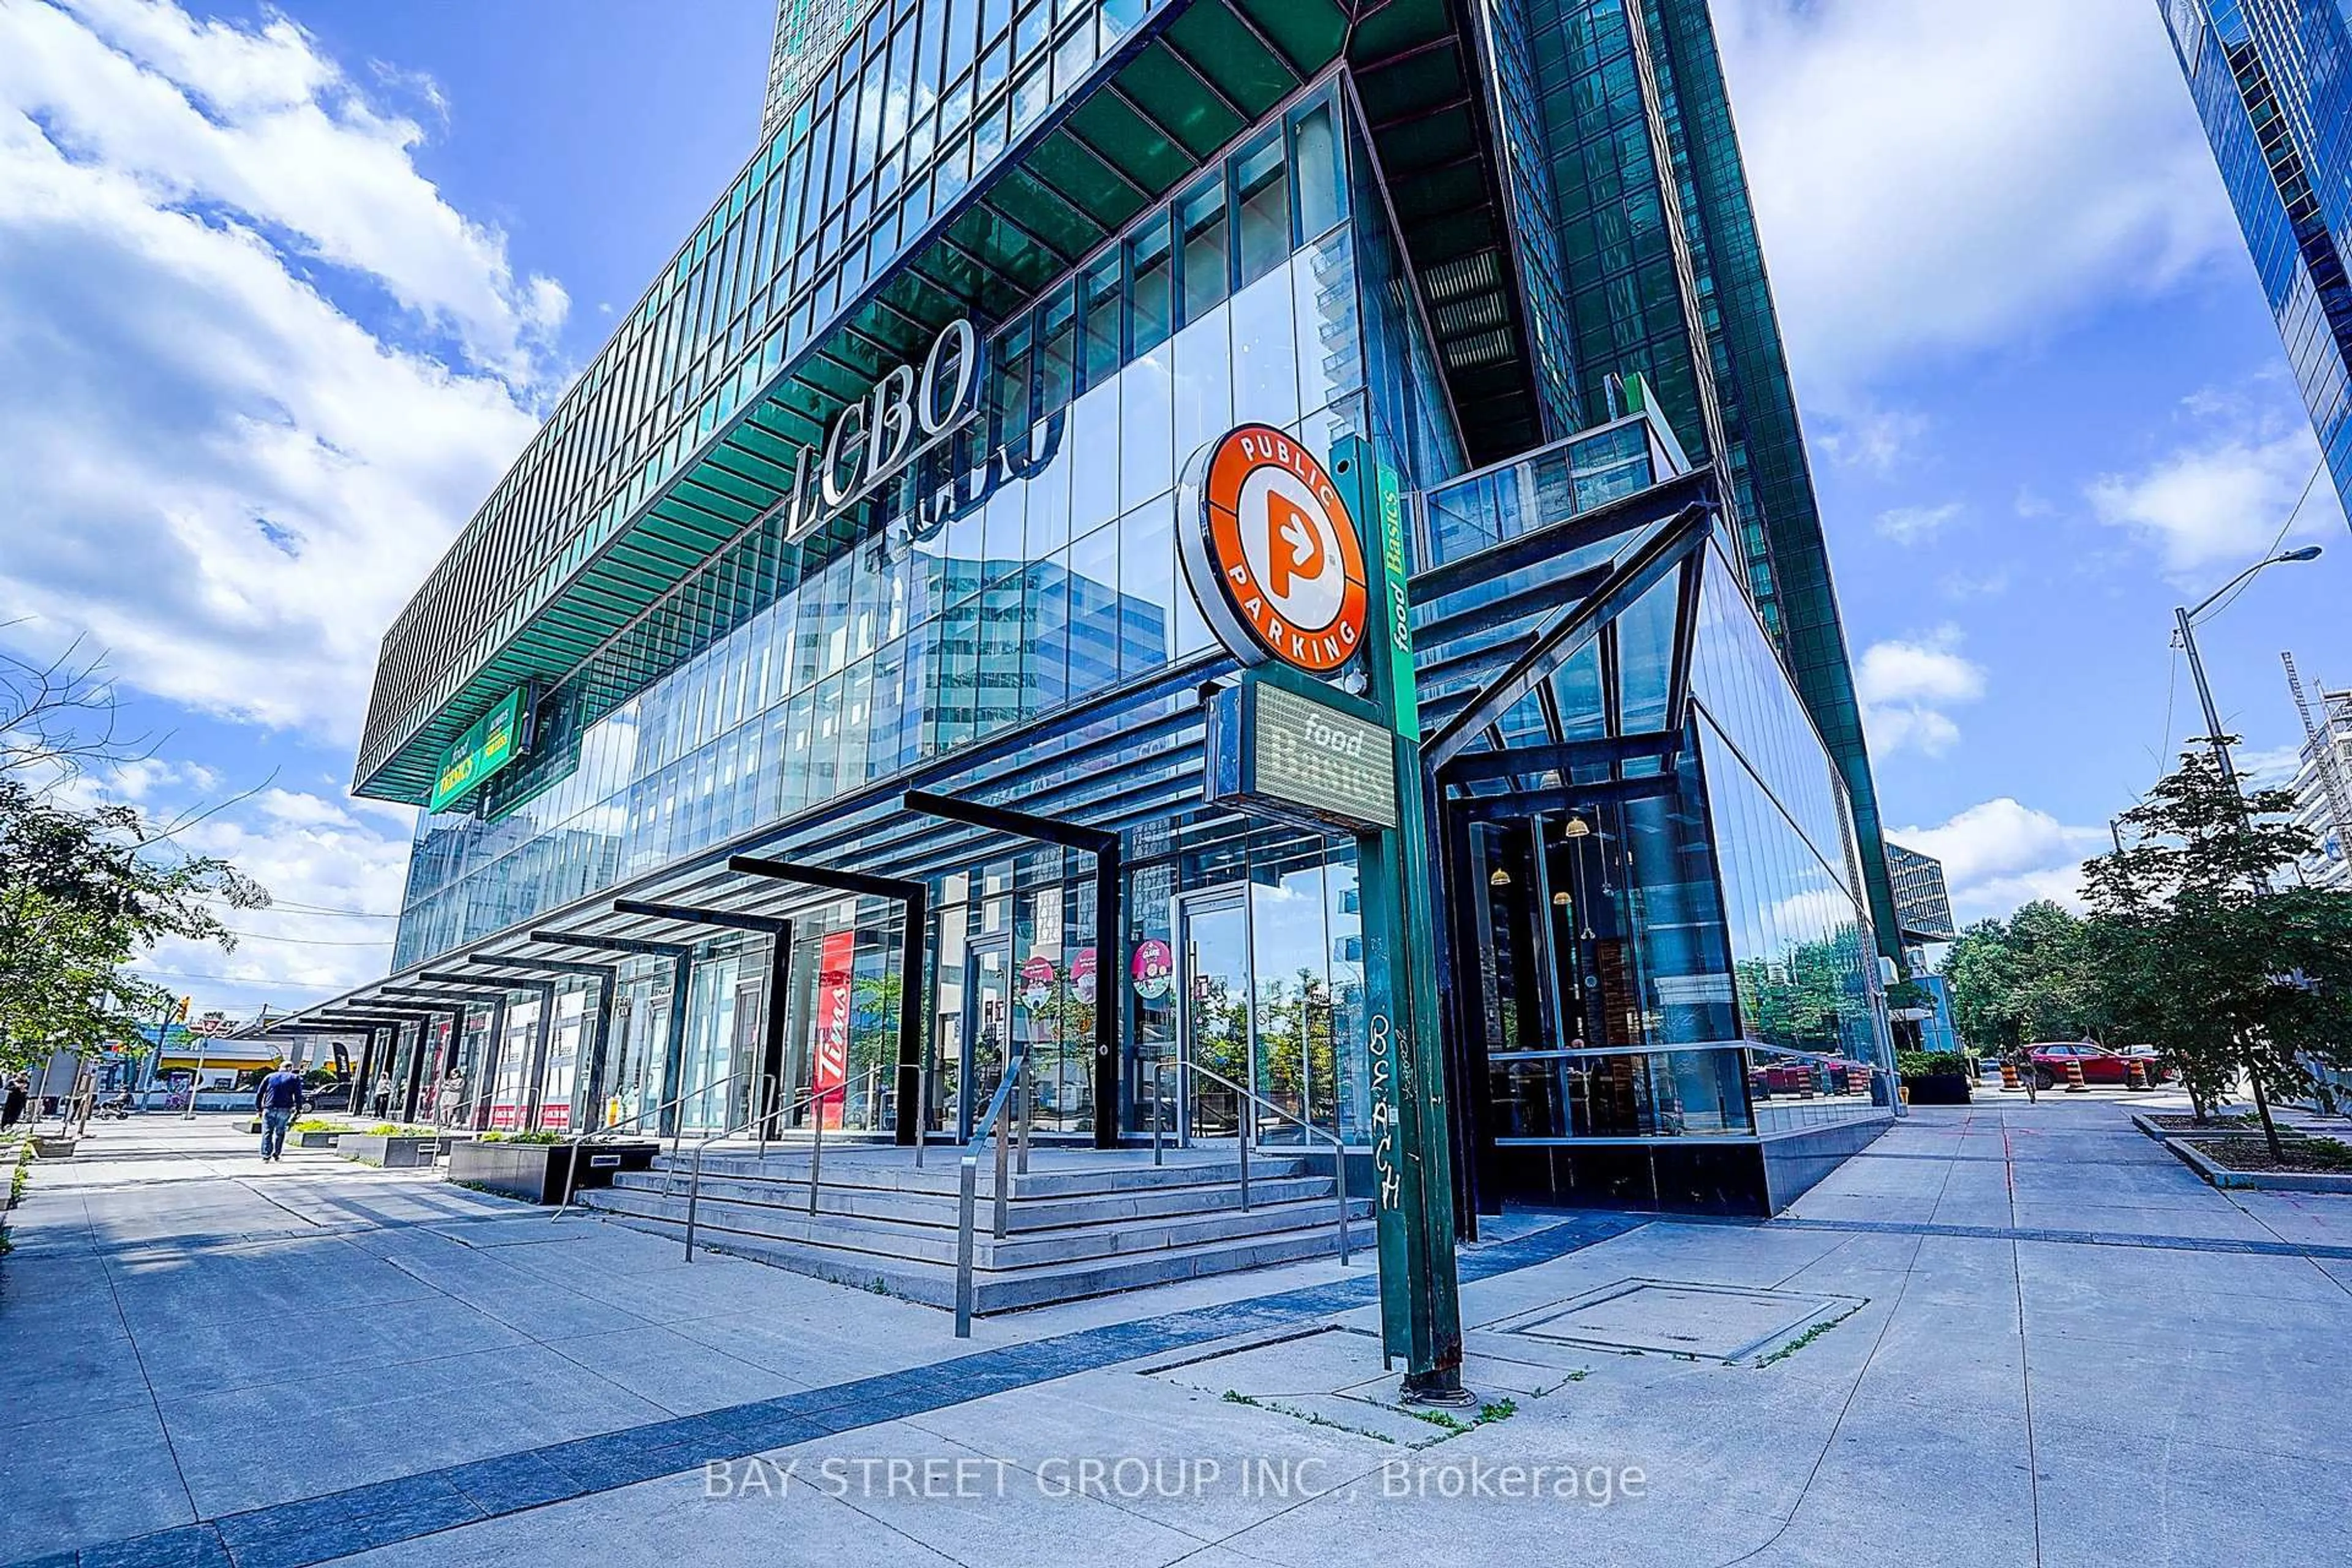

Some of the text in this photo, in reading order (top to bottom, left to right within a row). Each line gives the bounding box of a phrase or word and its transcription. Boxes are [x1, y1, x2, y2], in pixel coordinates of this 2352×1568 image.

[785, 318, 978, 544] LCBO
[1240, 435, 1334, 508] PUBLIC
[1267, 489, 1325, 599] P
[1383, 490, 1409, 654] food Basics
[1228, 560, 1356, 663] PARKING
[1304, 712, 1365, 758] food
[818, 986, 848, 1088] Tims
